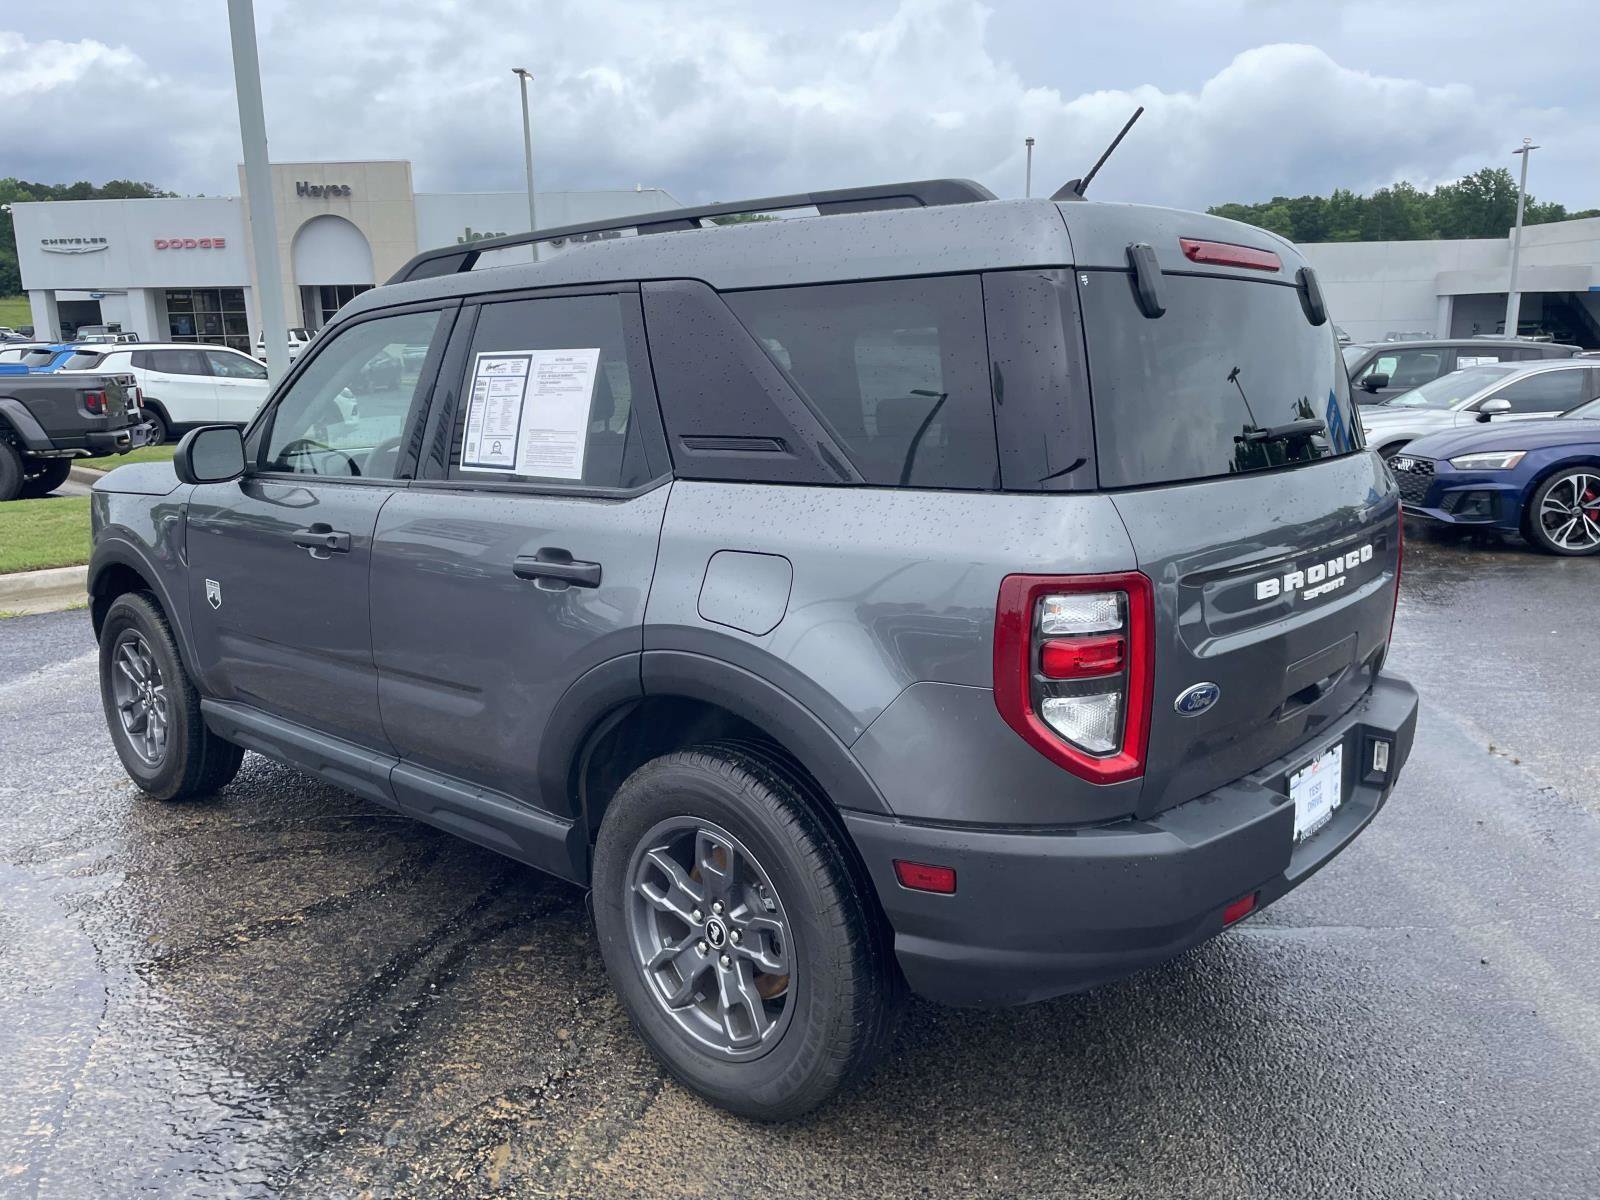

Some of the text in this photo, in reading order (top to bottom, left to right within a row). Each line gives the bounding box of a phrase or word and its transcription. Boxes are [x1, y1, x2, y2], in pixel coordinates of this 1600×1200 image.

[296, 181, 352, 199] Hayes
[41, 237, 107, 246] CHRYSLER
[154, 238, 226, 250] DODGE
[1256, 544, 1373, 600] BRONCO
[1303, 575, 1347, 601] SPORT
[1187, 689, 1213, 710] Ford
[1309, 780, 1322, 798] TEST
